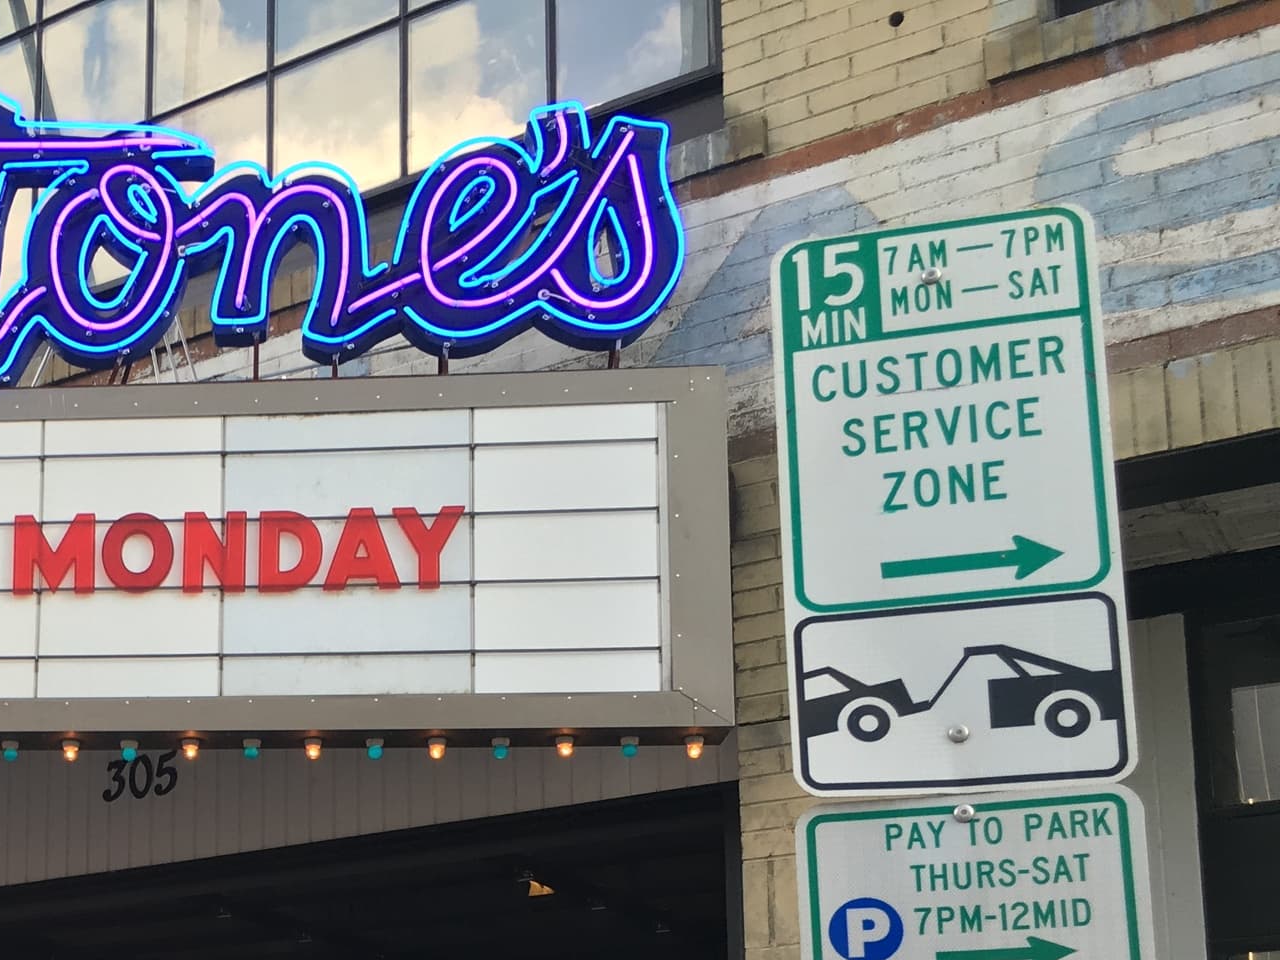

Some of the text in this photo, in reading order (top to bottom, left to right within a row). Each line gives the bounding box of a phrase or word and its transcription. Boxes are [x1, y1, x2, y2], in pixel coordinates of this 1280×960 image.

[792, 241, 866, 311] 15
[883, 240, 949, 276] 7AM
[1001, 222, 1066, 259] 7PM
[890, 281, 953, 317] MON
[1008, 264, 1062, 300] SAT
[800, 306, 867, 349] MIN
[811, 334, 1066, 403] CUSTOMER
[841, 396, 1043, 458] SERVICE
[881, 459, 1008, 514] ZONE
[13, 504, 467, 597] MONDAY
[102, 748, 178, 803] 305
[885, 807, 1113, 852] PAY TO PARK
[910, 852, 1091, 893] THURS-SAT
[845, 907, 891, 959] P
[913, 897, 1093, 936] 7PM-12MID
